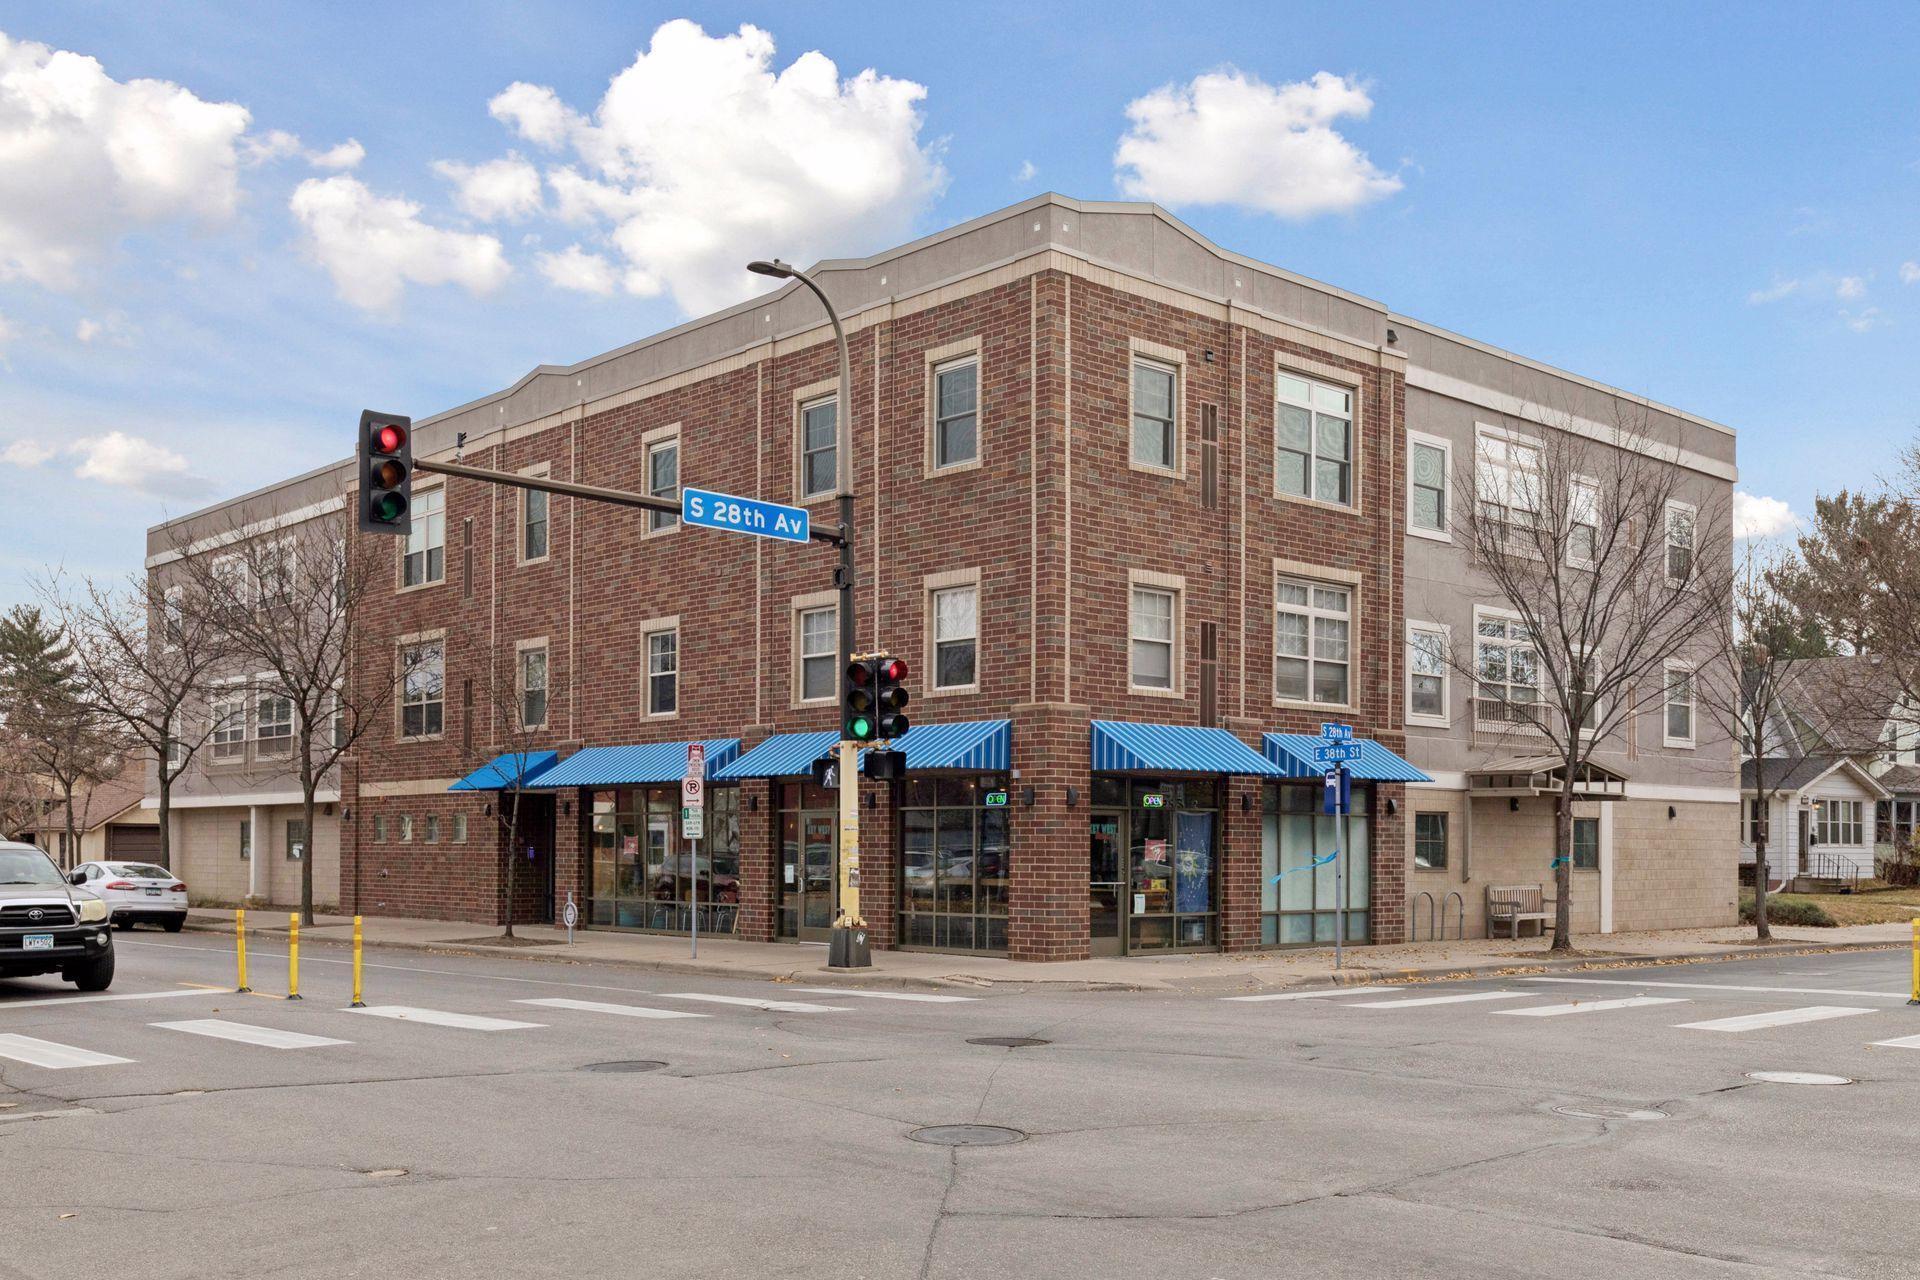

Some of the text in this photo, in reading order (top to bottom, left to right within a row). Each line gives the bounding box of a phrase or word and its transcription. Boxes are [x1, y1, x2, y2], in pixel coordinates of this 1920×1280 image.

[690, 497, 802, 534] S 28th Av
[1322, 726, 1351, 738] S 28th Av
[1315, 746, 1360, 760] E 38th St
[988, 795, 1005, 803] OEN
[1144, 796, 1162, 805] OPEN
